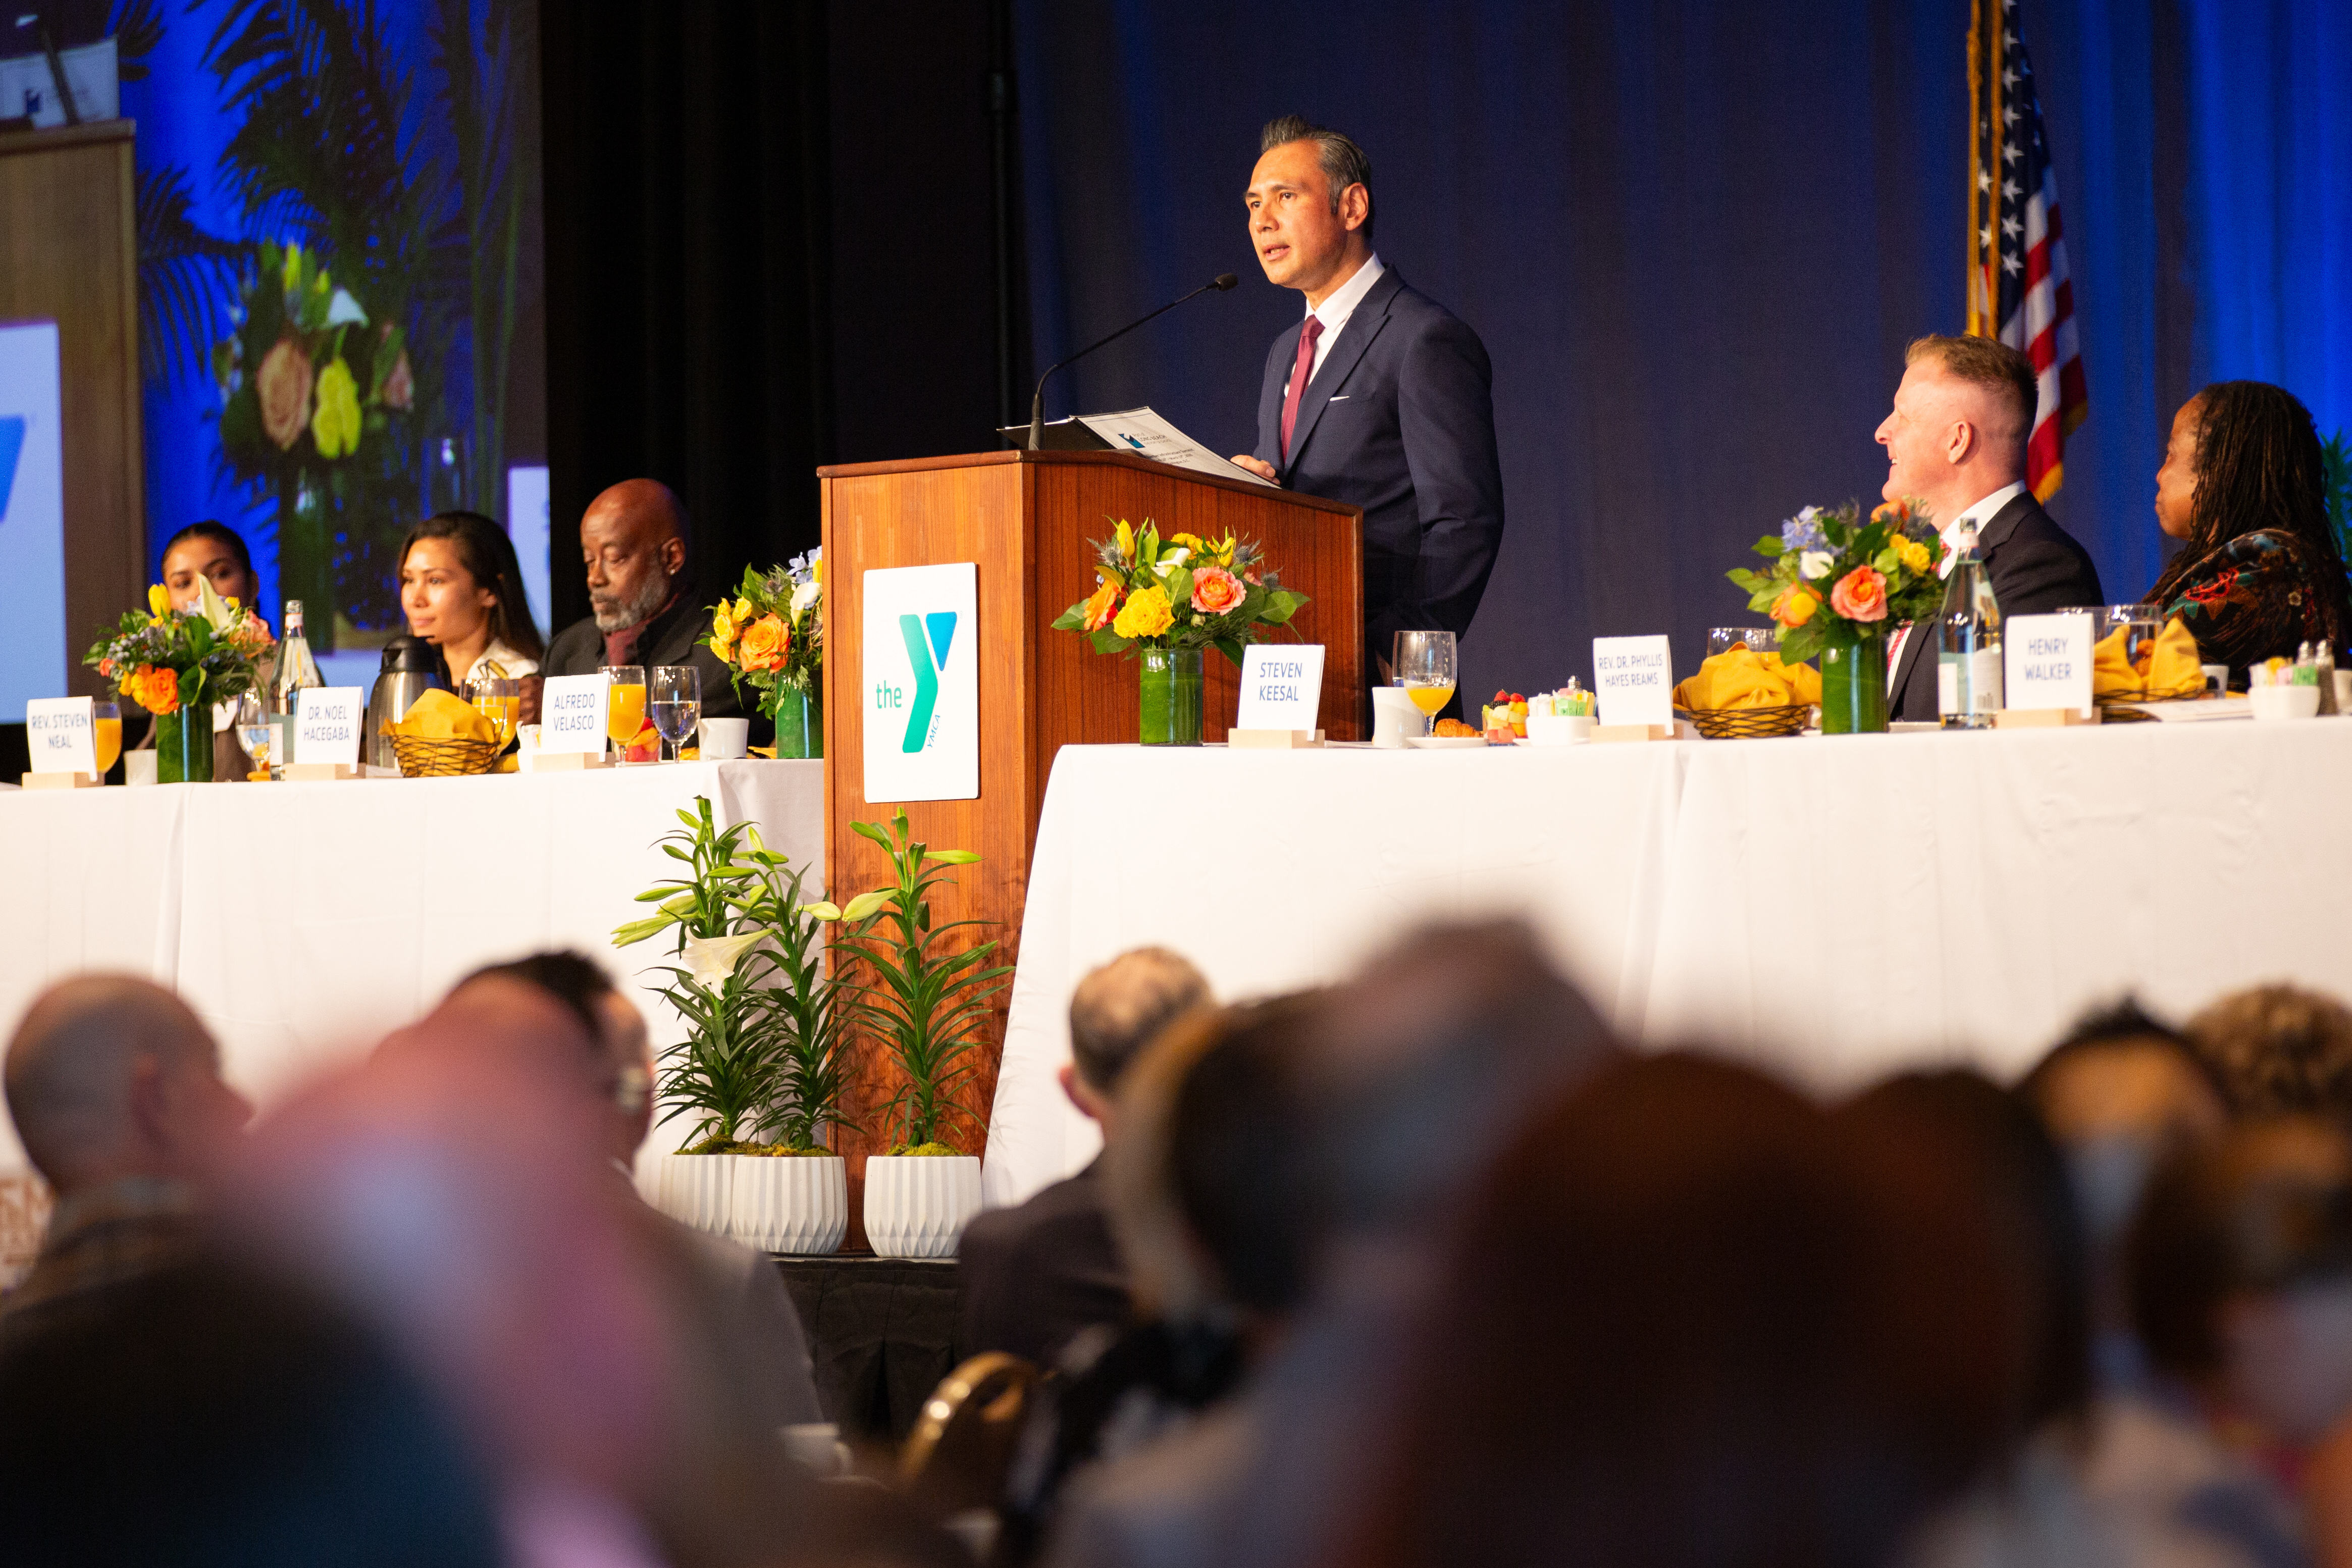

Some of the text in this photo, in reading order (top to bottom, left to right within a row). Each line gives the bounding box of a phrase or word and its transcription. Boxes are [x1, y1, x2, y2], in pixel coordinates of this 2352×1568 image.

[2028, 638, 2068, 656] HENRY
[1599, 654, 1662, 669] REV. DR. PHYLLIS
[1260, 662, 1302, 678] STEVEN
[2024, 663, 2072, 681] WALKER
[1605, 672, 1658, 687] HAYES REAMS
[554, 693, 595, 709] ALFREDO
[876, 680, 902, 709] the
[1259, 685, 1299, 702] KEESAL
[308, 705, 347, 720] DR. NOEL
[32, 713, 88, 729] REV. STEVEN
[553, 714, 594, 730] VELASCO
[304, 726, 350, 741] HACEGABA
[927, 714, 940, 748] YMCA
[48, 734, 72, 749] NEAL
